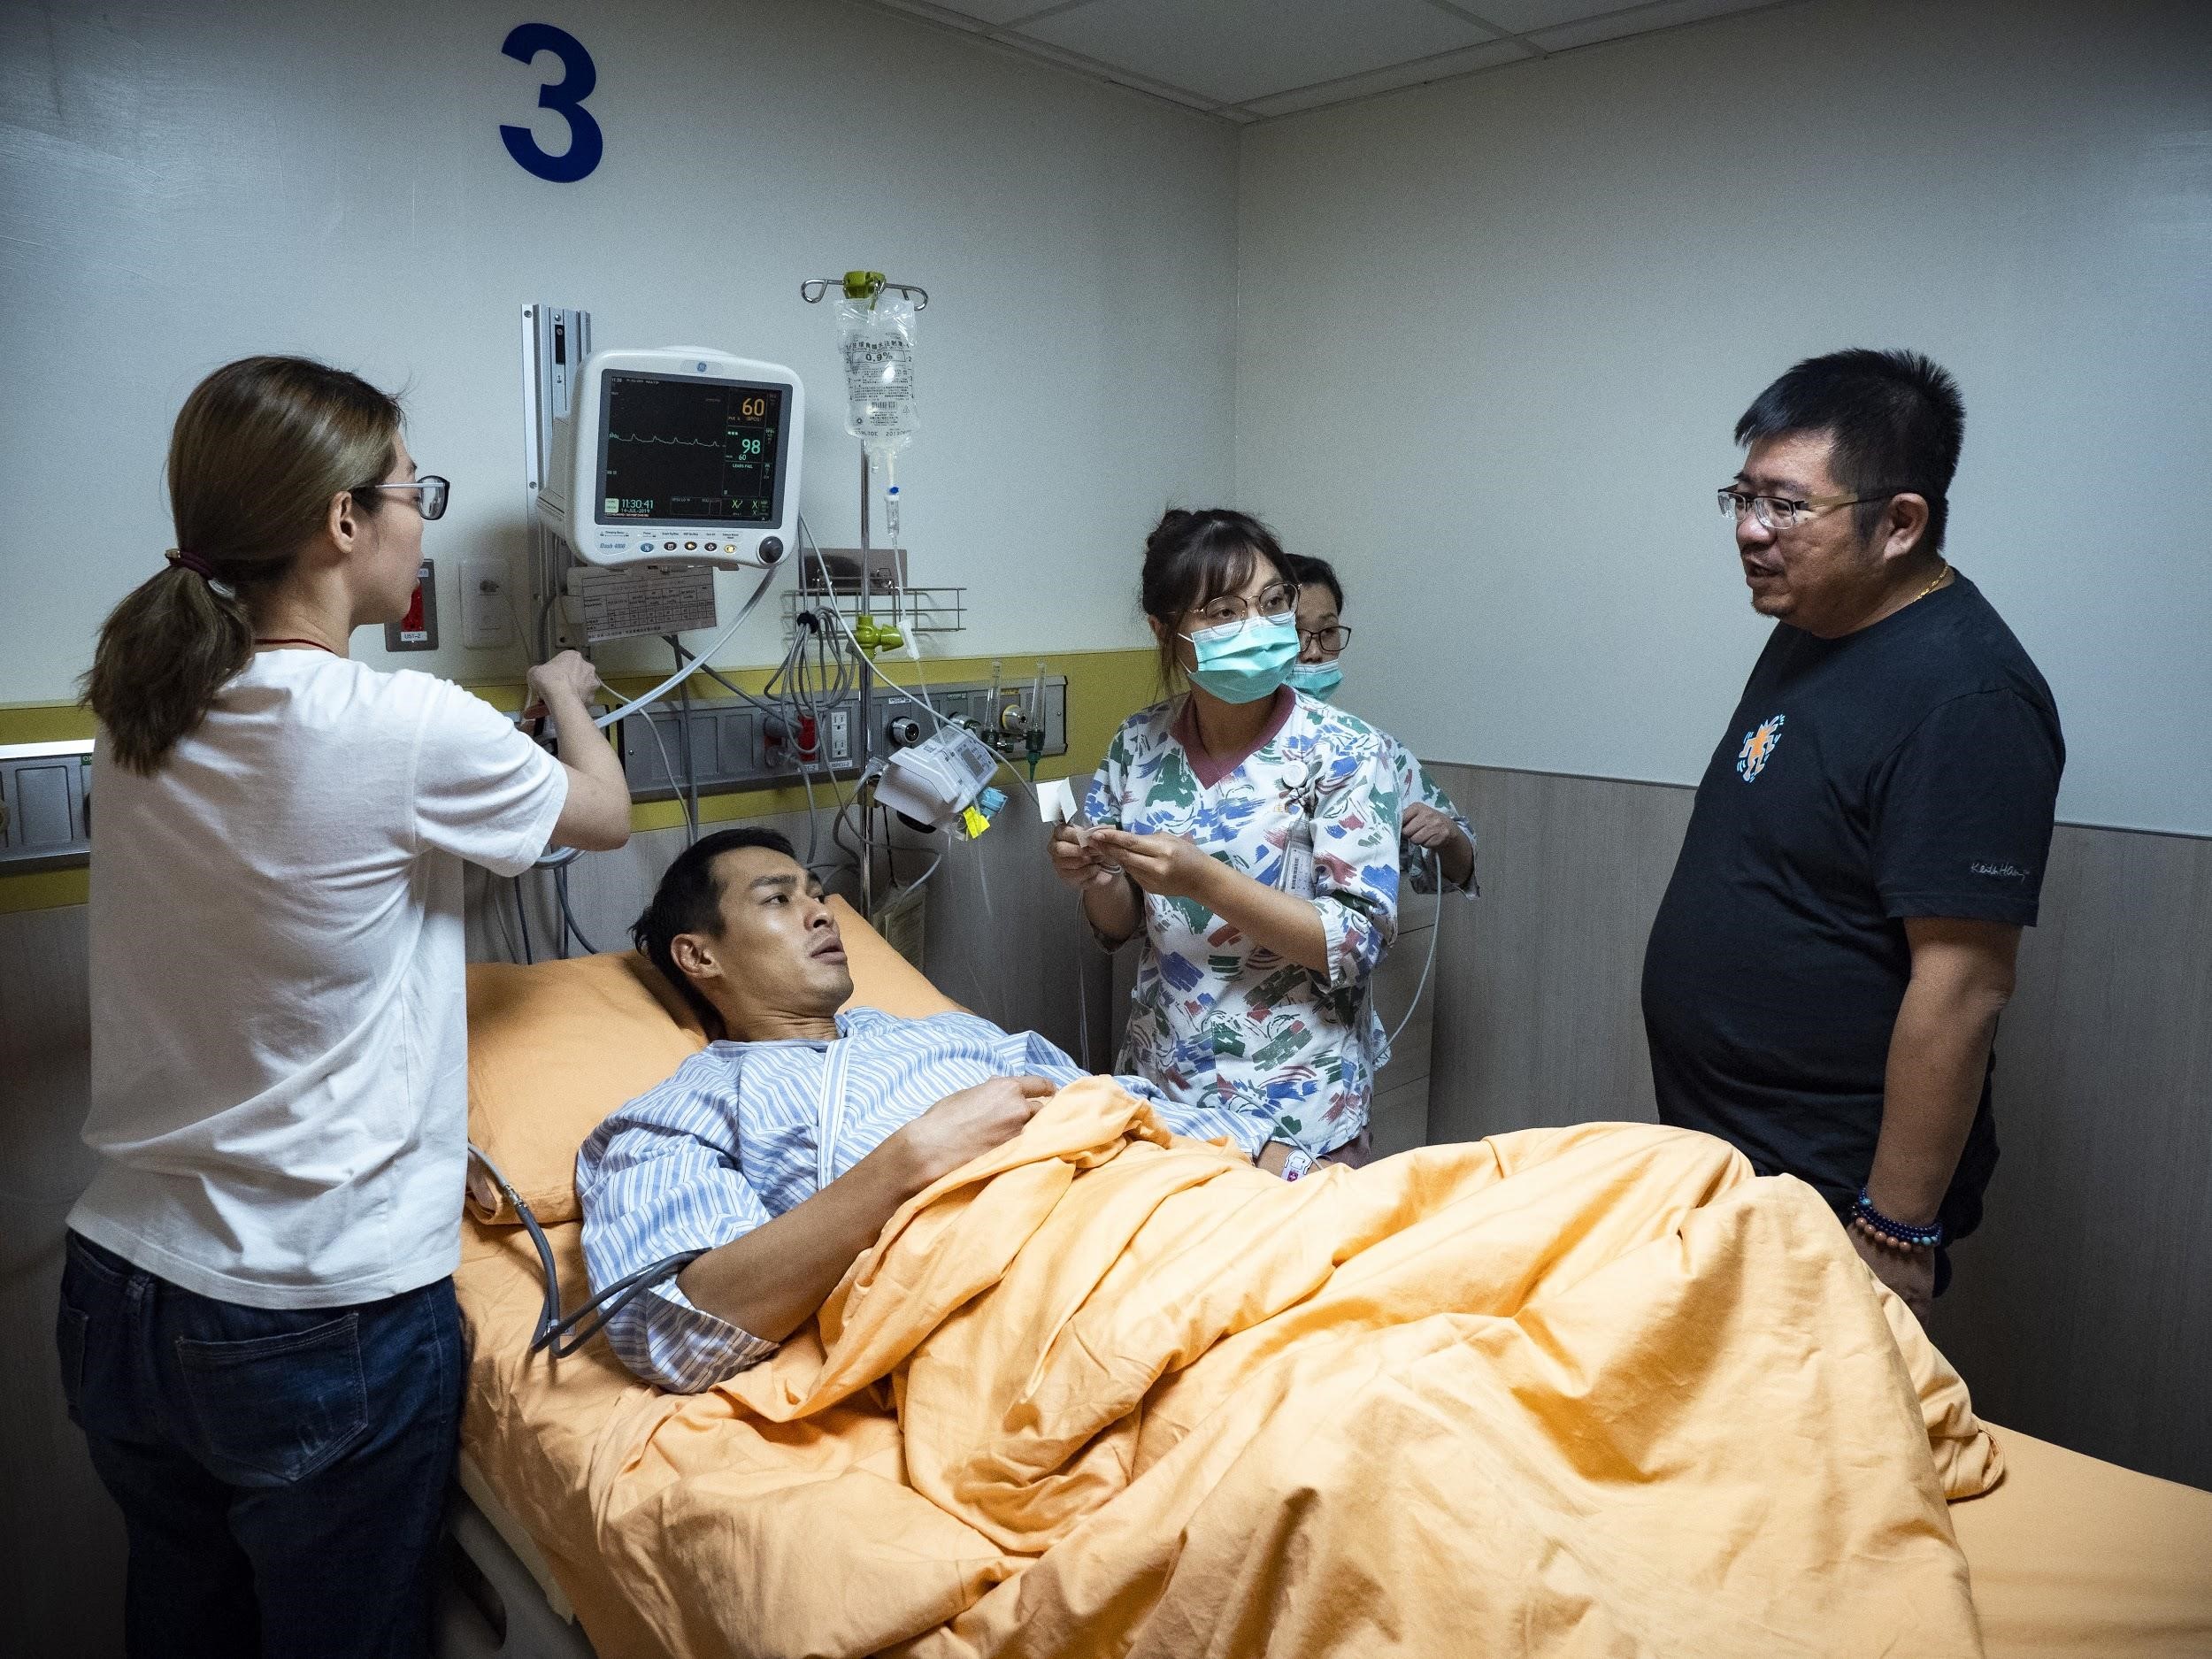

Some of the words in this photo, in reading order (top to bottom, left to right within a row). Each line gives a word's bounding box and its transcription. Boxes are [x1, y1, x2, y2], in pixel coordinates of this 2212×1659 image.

[500, 23, 603, 183] 3
[865, 352, 893, 362] 0.9%
[742, 398, 764, 417] 60
[741, 439, 761, 455] 98
[621, 498, 653, 510] 11:30:41
[1970, 862, 1999, 875] Keith
